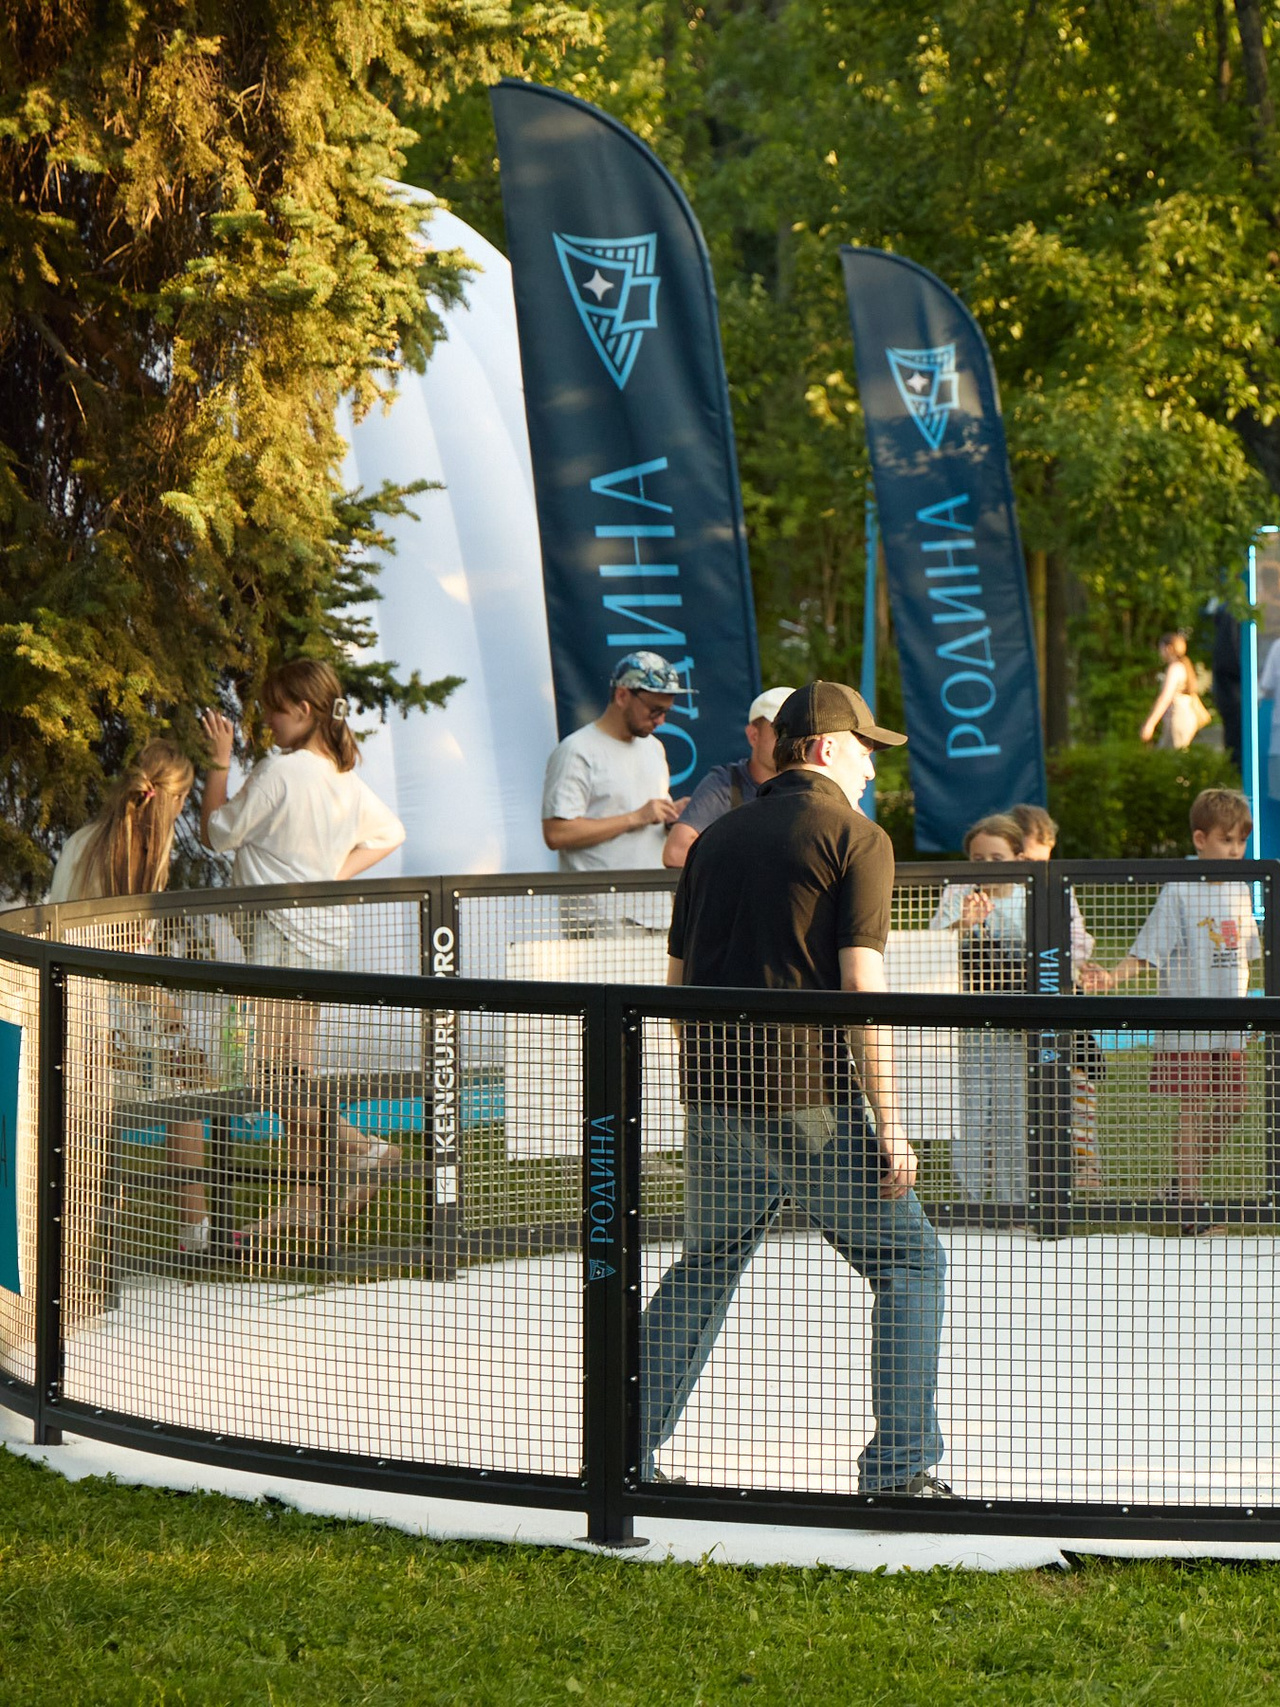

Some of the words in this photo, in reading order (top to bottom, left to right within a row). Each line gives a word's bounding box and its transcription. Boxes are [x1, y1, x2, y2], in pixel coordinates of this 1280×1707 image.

[916, 493, 1000, 759] РОДИНА
[433, 926, 455, 977] RO
[589, 1114, 616, 1244] РОДИНА
